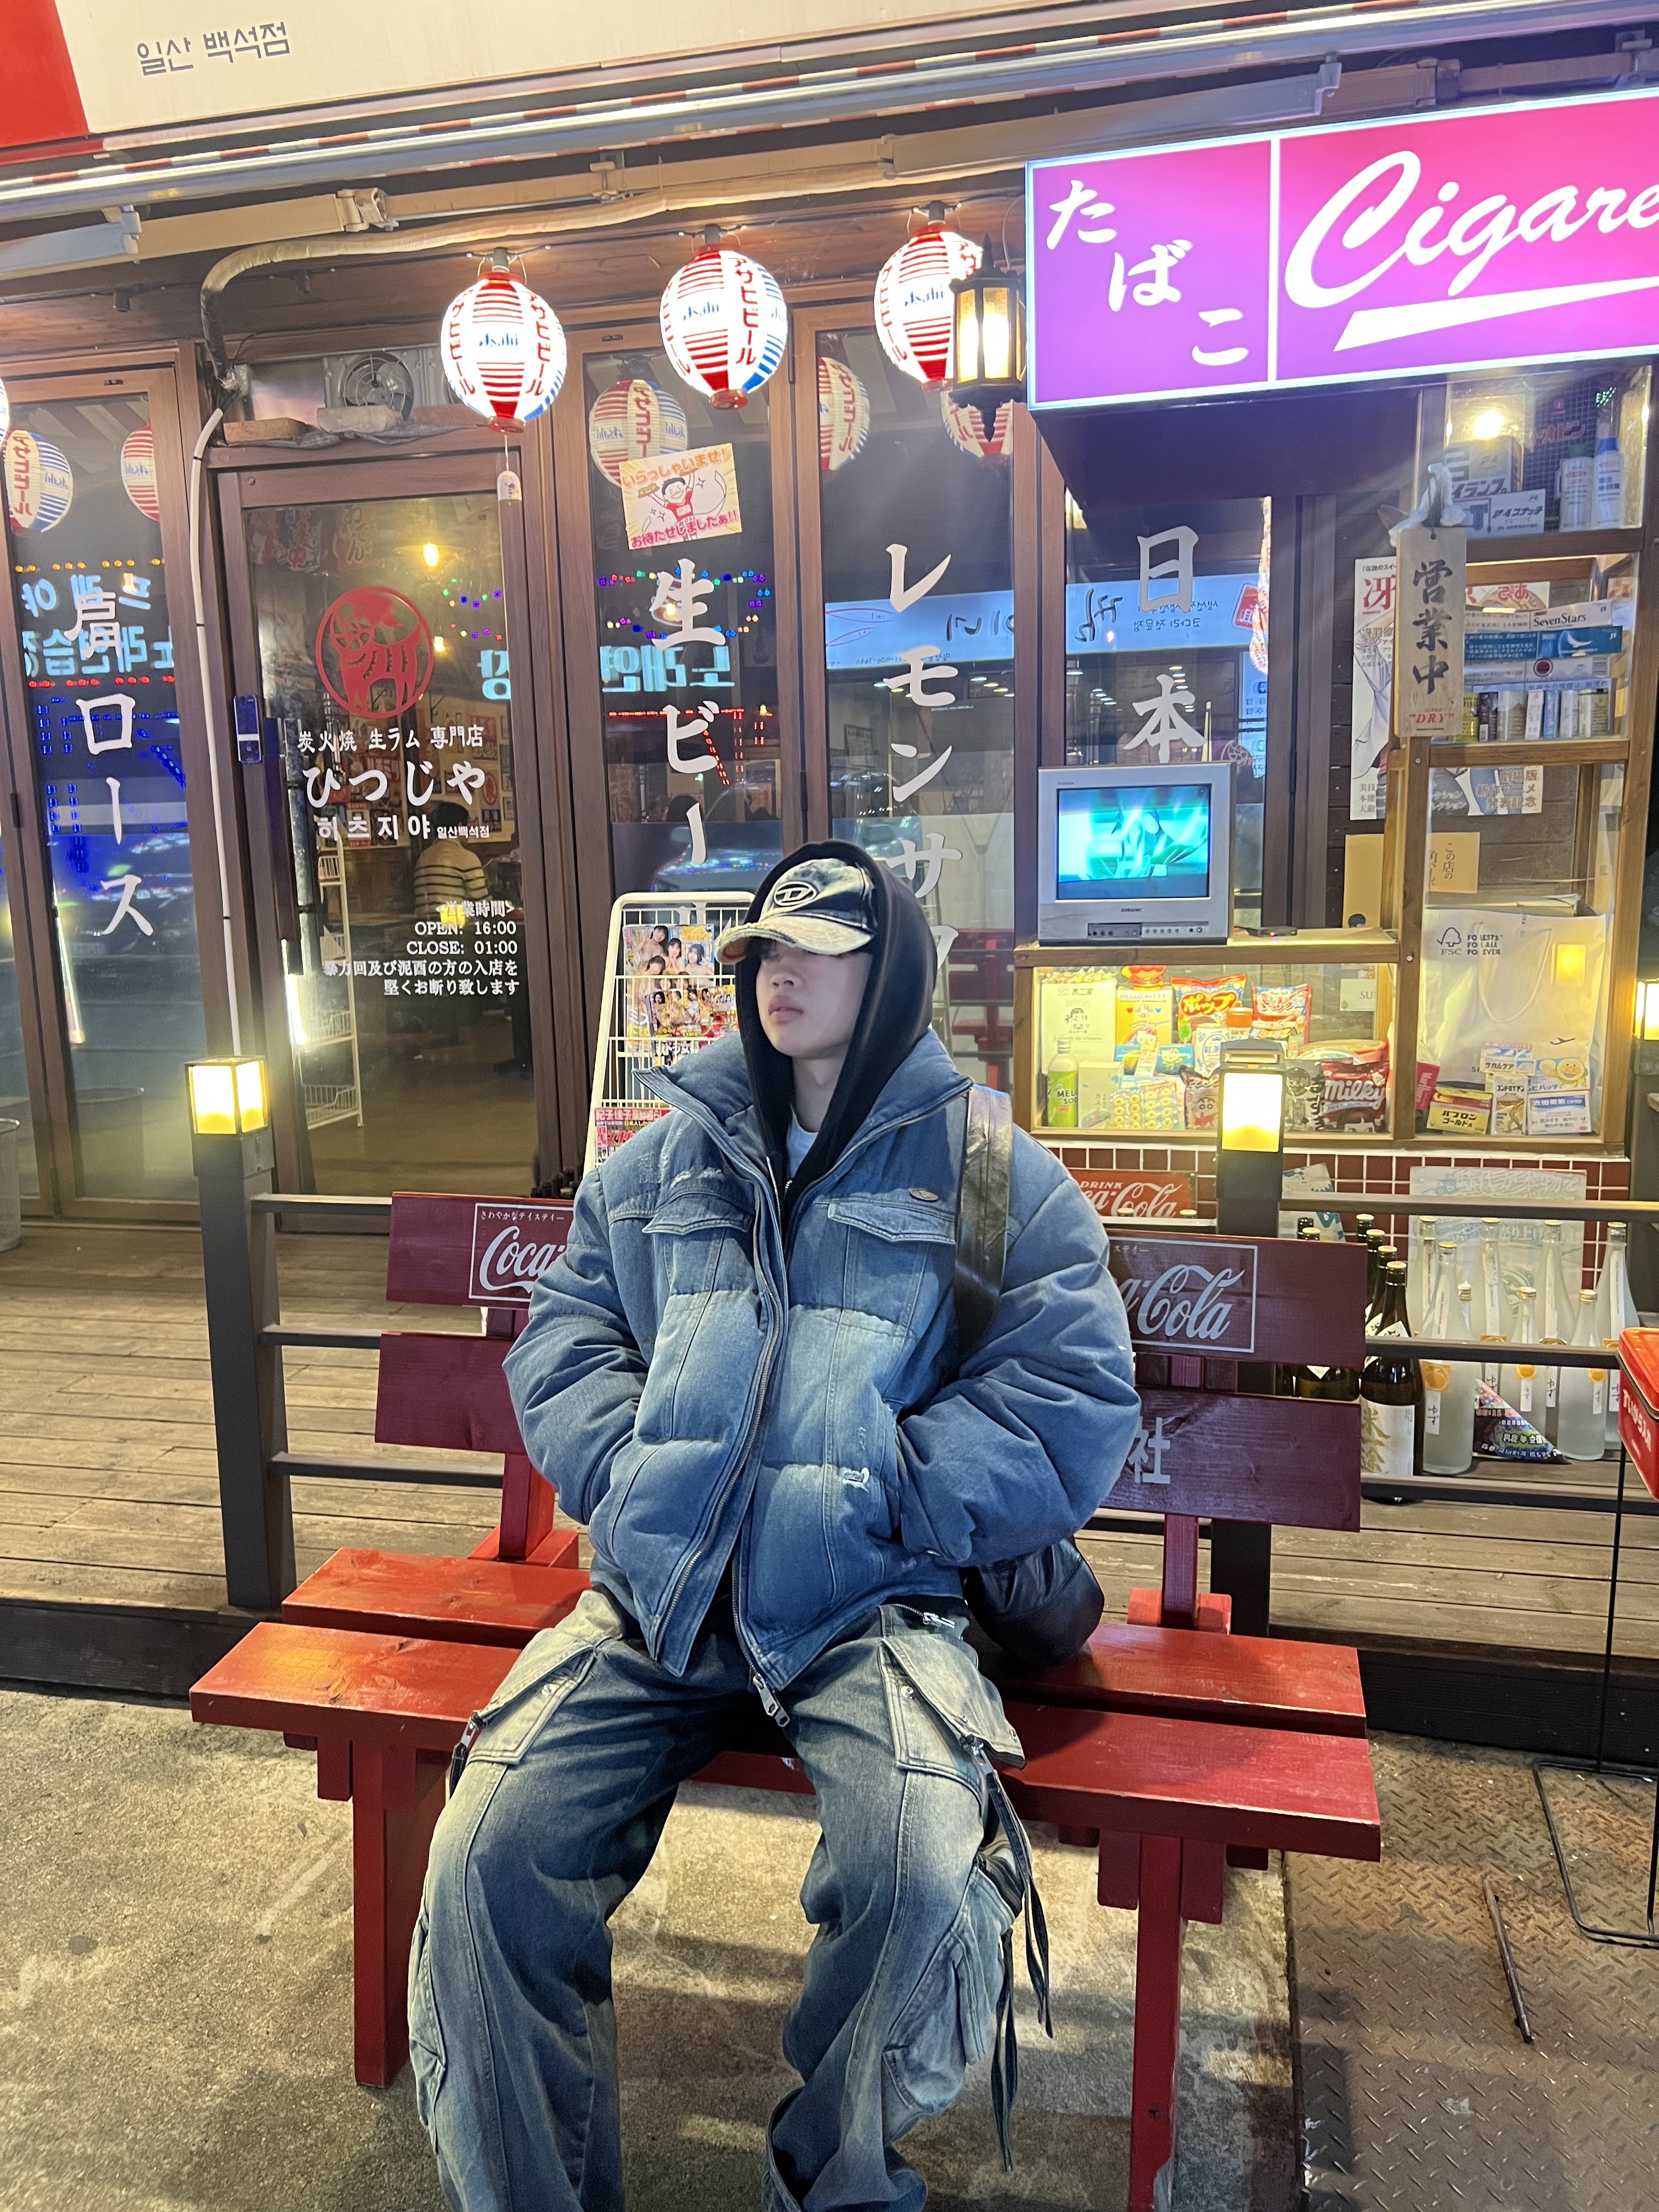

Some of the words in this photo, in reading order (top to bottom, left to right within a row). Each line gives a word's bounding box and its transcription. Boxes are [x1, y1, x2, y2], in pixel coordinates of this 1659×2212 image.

[137, 37, 194, 76] 일산
[202, 21, 291, 64] 백석점
[1046, 179, 1249, 366] たばこ
[682, 300, 720, 321] Asahi
[728, 257, 759, 365] アサヒビール
[904, 286, 944, 307] Asahi
[478, 333, 518, 347] Asahi
[524, 291, 551, 396] アサヒビール
[1412, 560, 1453, 696] 営業中
[1124, 526, 1207, 764] 日本
[368, 727, 420, 751] 生ラム
[430, 724, 485, 749] 専門店
[64, 591, 154, 937] 肩ロース
[302, 760, 486, 808] ひつじや
[437, 826, 490, 839] 일산백석점
[415, 921, 464, 935] OPEN:
[474, 921, 517, 935] 16:00
[406, 941, 465, 955] CLOSE:
[474, 940, 518, 955] 01:00
[1324, 1079, 1386, 1110] Milky
[1079, 1181, 1124, 1189] DRINK
